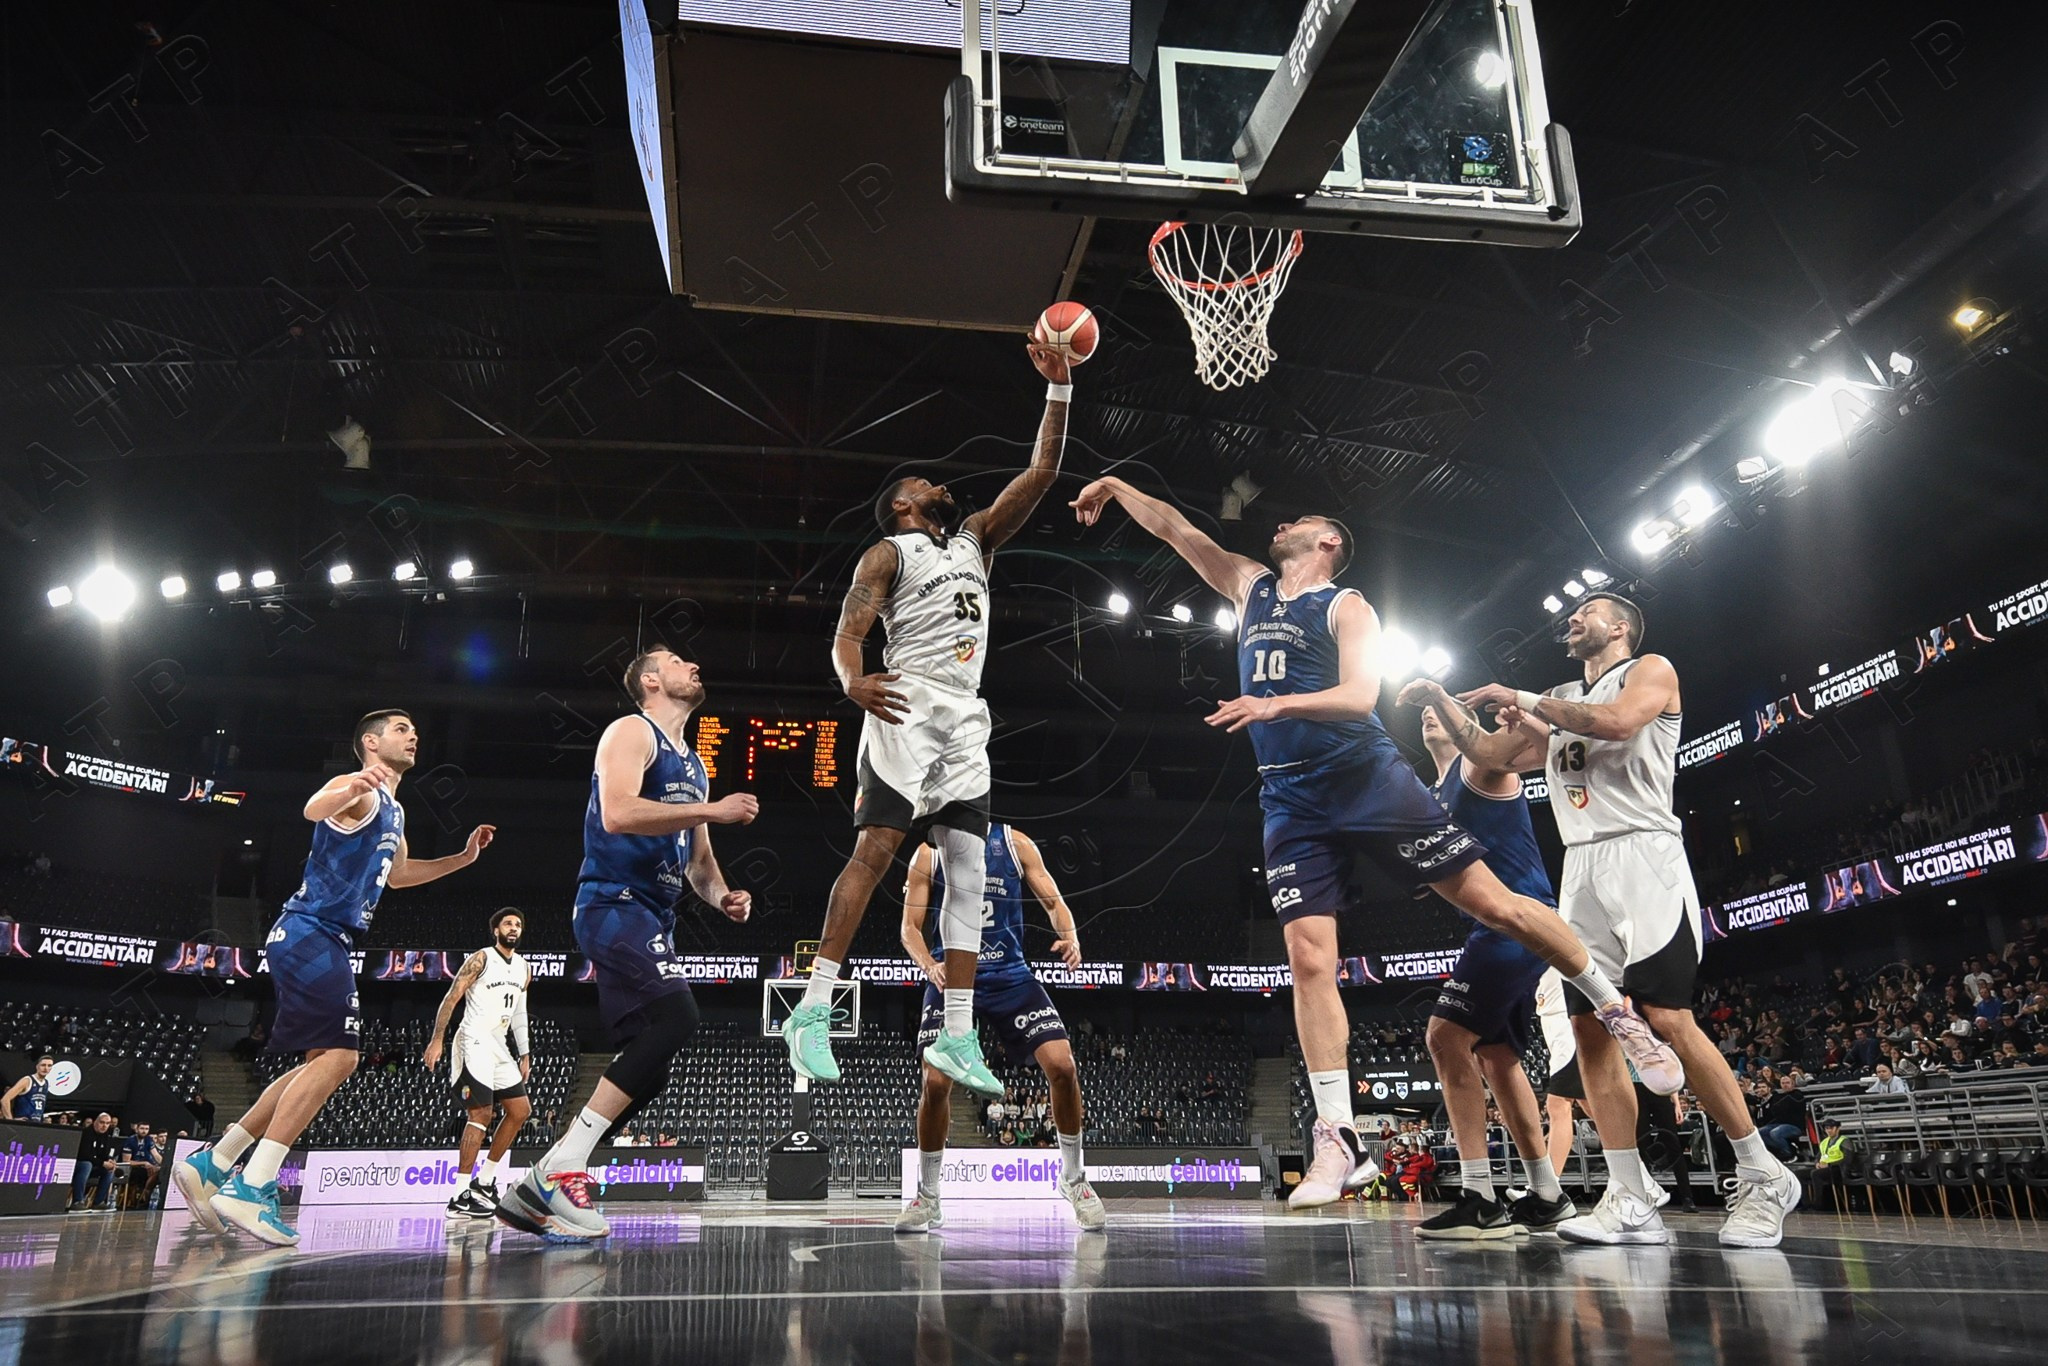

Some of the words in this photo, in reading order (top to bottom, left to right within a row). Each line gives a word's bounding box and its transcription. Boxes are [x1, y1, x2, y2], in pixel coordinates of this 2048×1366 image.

[1291, 0, 1340, 86] sport
[1020, 121, 1064, 131] oneteam
[1460, 176, 1503, 186] EuroCup
[953, 592, 981, 622] 35
[1988, 602, 1998, 612] TU
[1999, 595, 2015, 608] FACI
[2040, 580, 2048, 589] NO
[1252, 650, 1286, 682] 10
[1815, 659, 1899, 710] ACCIDENTĂRI
[76, 754, 91, 762] FACI
[1559, 741, 1585, 772] 13
[1679, 728, 1743, 769] ACCIDENTĂRI
[65, 761, 167, 793] ACCIDENTĂRI
[1895, 855, 1904, 863] TU
[1905, 850, 1921, 861] FACI
[1945, 840, 1957, 849] NOI
[1958, 837, 1968, 846] NE
[2000, 825, 2012, 835] DE
[1903, 837, 2016, 885] ACCIDENTĂRI
[1272, 888, 1300, 908] mCo
[1723, 903, 1730, 911] TU
[982, 901, 995, 927] 2
[1729, 893, 1809, 930] ACCIDENTĂRI
[52, 929, 68, 937] FACI
[38, 937, 154, 964] ACCIDENTĂRI
[682, 963, 757, 978] CIDENTĂRI
[851, 966, 928, 981] ACCIDENT
[1035, 968, 1122, 984] ACCIDENTĂRI
[1210, 971, 1293, 987] ACCIDENTĂR
[504, 993, 513, 1008] 11
[35, 1100, 42, 1110] 15
[319, 1162, 400, 1192] pentru
[938, 1160, 987, 1182] ntru
